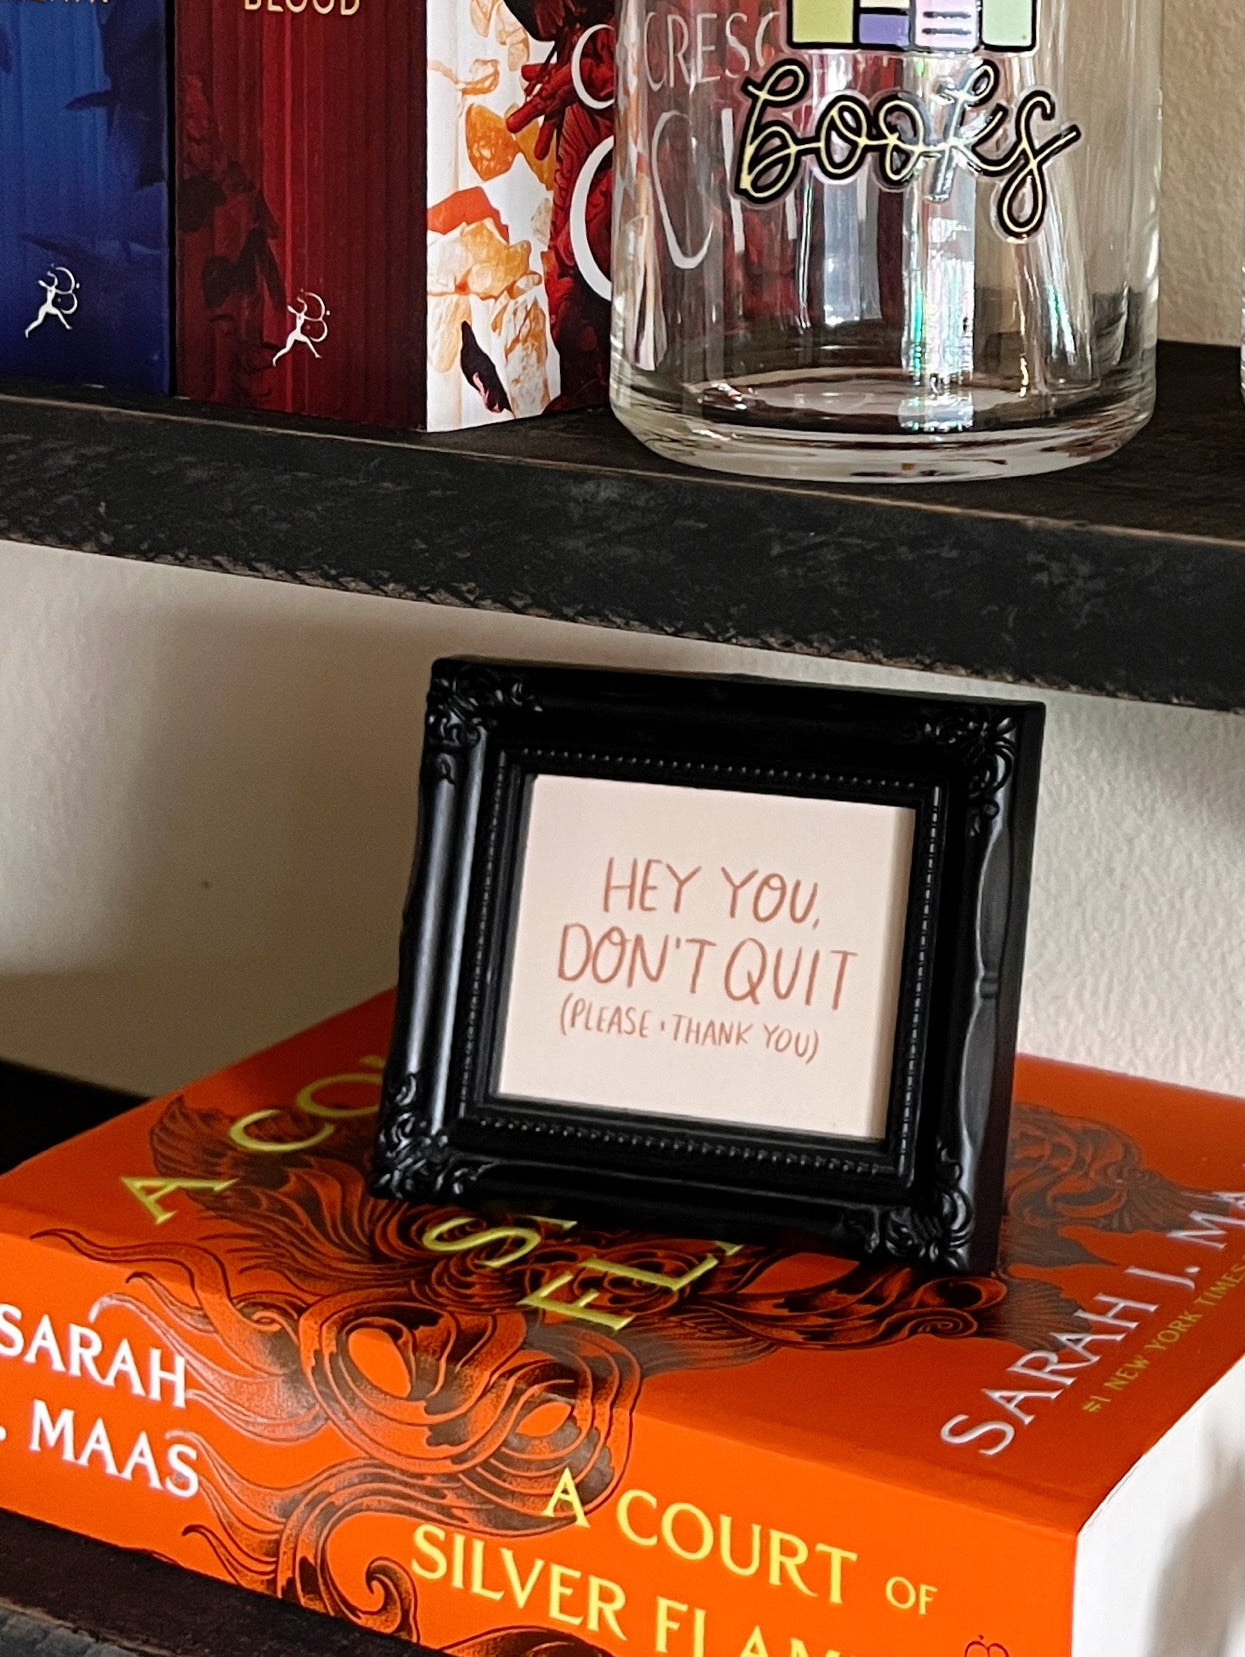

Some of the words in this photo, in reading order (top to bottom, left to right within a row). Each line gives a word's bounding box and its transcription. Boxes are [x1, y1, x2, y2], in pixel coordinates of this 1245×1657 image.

[733, 57, 1082, 239] books
[602, 856, 702, 913] HEY
[721, 865, 821, 930] YOU,
[557, 922, 717, 995] DON'T
[724, 936, 859, 1011] QUIT
[560, 992, 654, 1039] (PLEASE
[672, 1013, 754, 1046] THANK
[762, 1022, 820, 1065] YOU)
[0, 1302, 187, 1409] SARAH
[939, 1292, 1159, 1457] SARAH
[1124, 1264, 1201, 1292] J.
[1081, 1393, 1112, 1413] #1
[1103, 1353, 1151, 1392] NEW
[1145, 1308, 1203, 1352] YORK
[29, 1398, 200, 1498] MAAS
[411, 1524, 629, 1642] SILVER
[543, 1467, 591, 1528] A
[616, 1489, 859, 1605] COURT
[885, 1575, 938, 1616] OF
